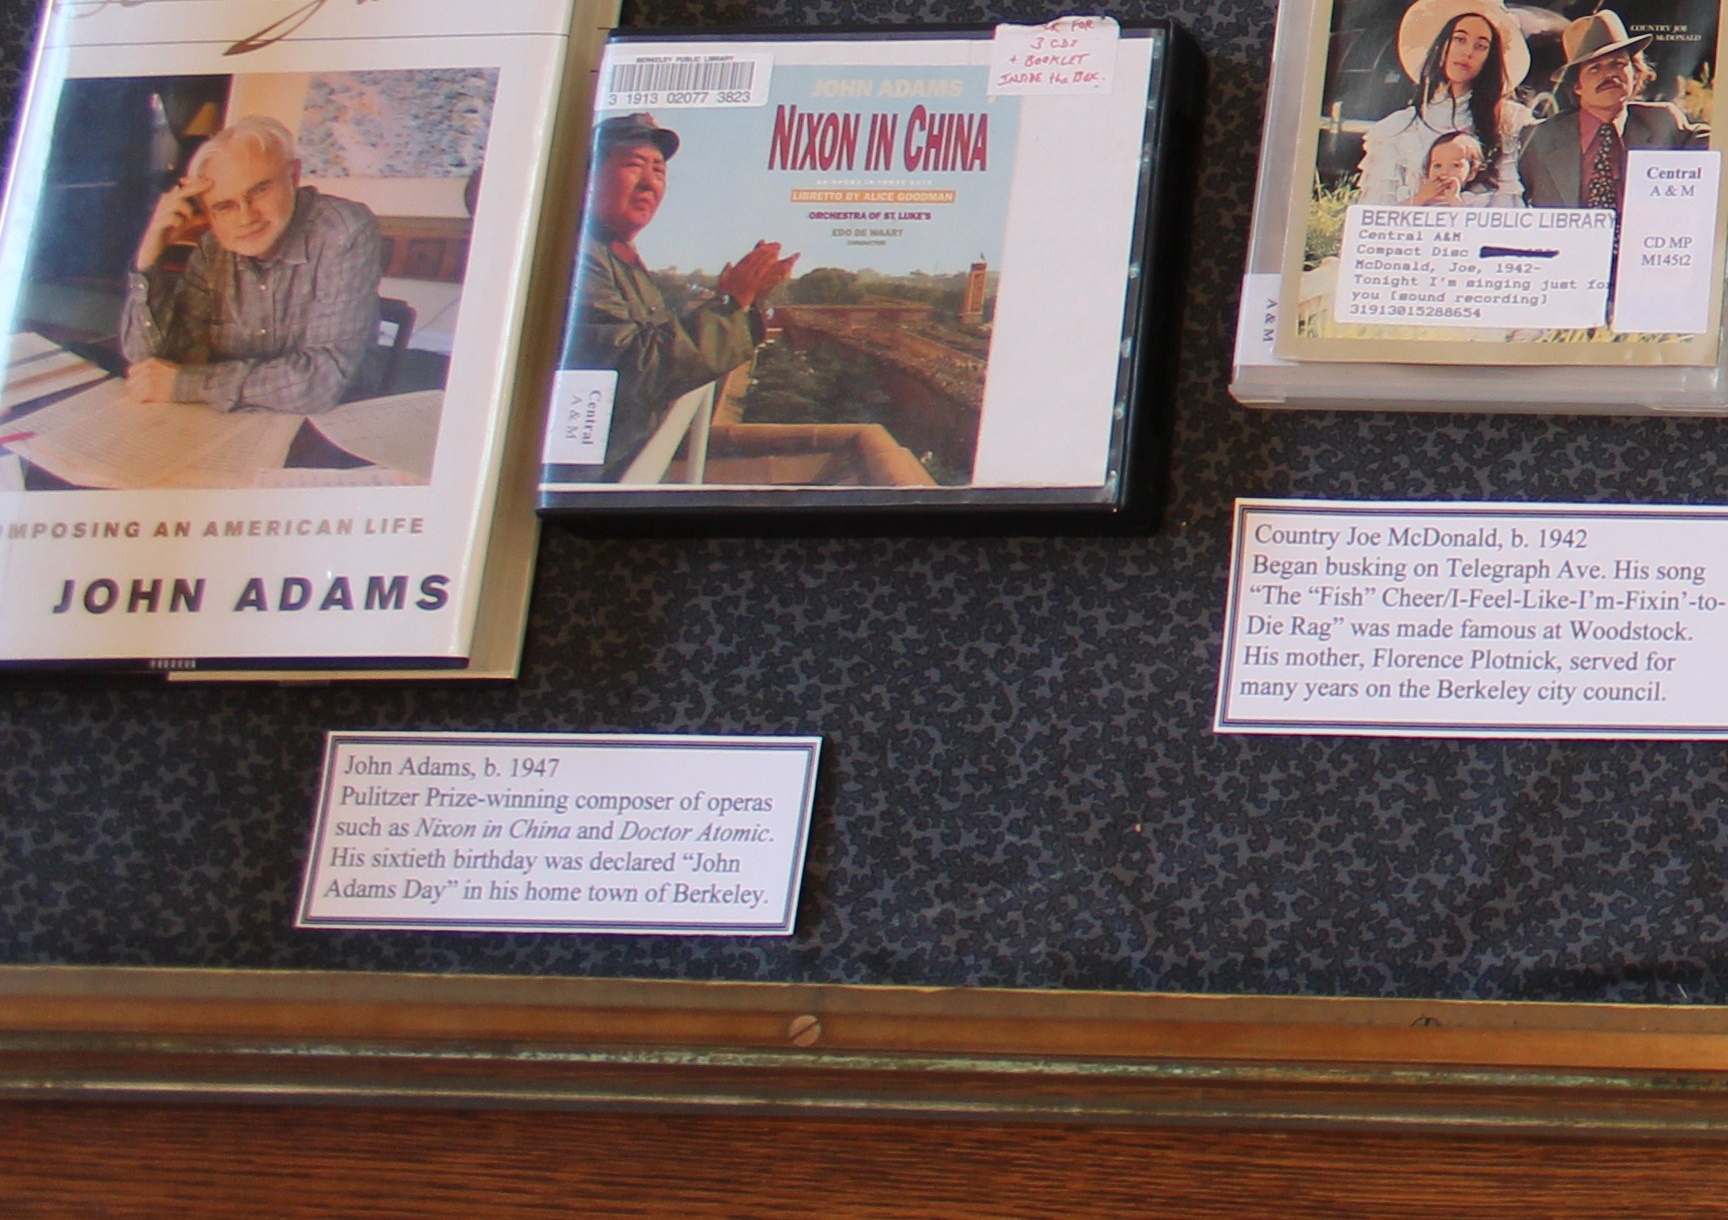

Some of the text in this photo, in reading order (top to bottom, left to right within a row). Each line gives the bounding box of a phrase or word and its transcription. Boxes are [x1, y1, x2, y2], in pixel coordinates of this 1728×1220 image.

[609, 90, 751, 105] 3 1913 02077 3823
[864, 113, 898, 171] IN
[1361, 211, 1617, 229] BERKELEY PUBLIC LIBRARY
[0, 517, 425, 538] MPOSING AN AMERICAN LIFE
[1254, 523, 1588, 551] Country Joe McDonald, b. 1942
[52, 574, 451, 614] JOHN ADAMS
[343, 754, 561, 781] John Adams, b. 1947
